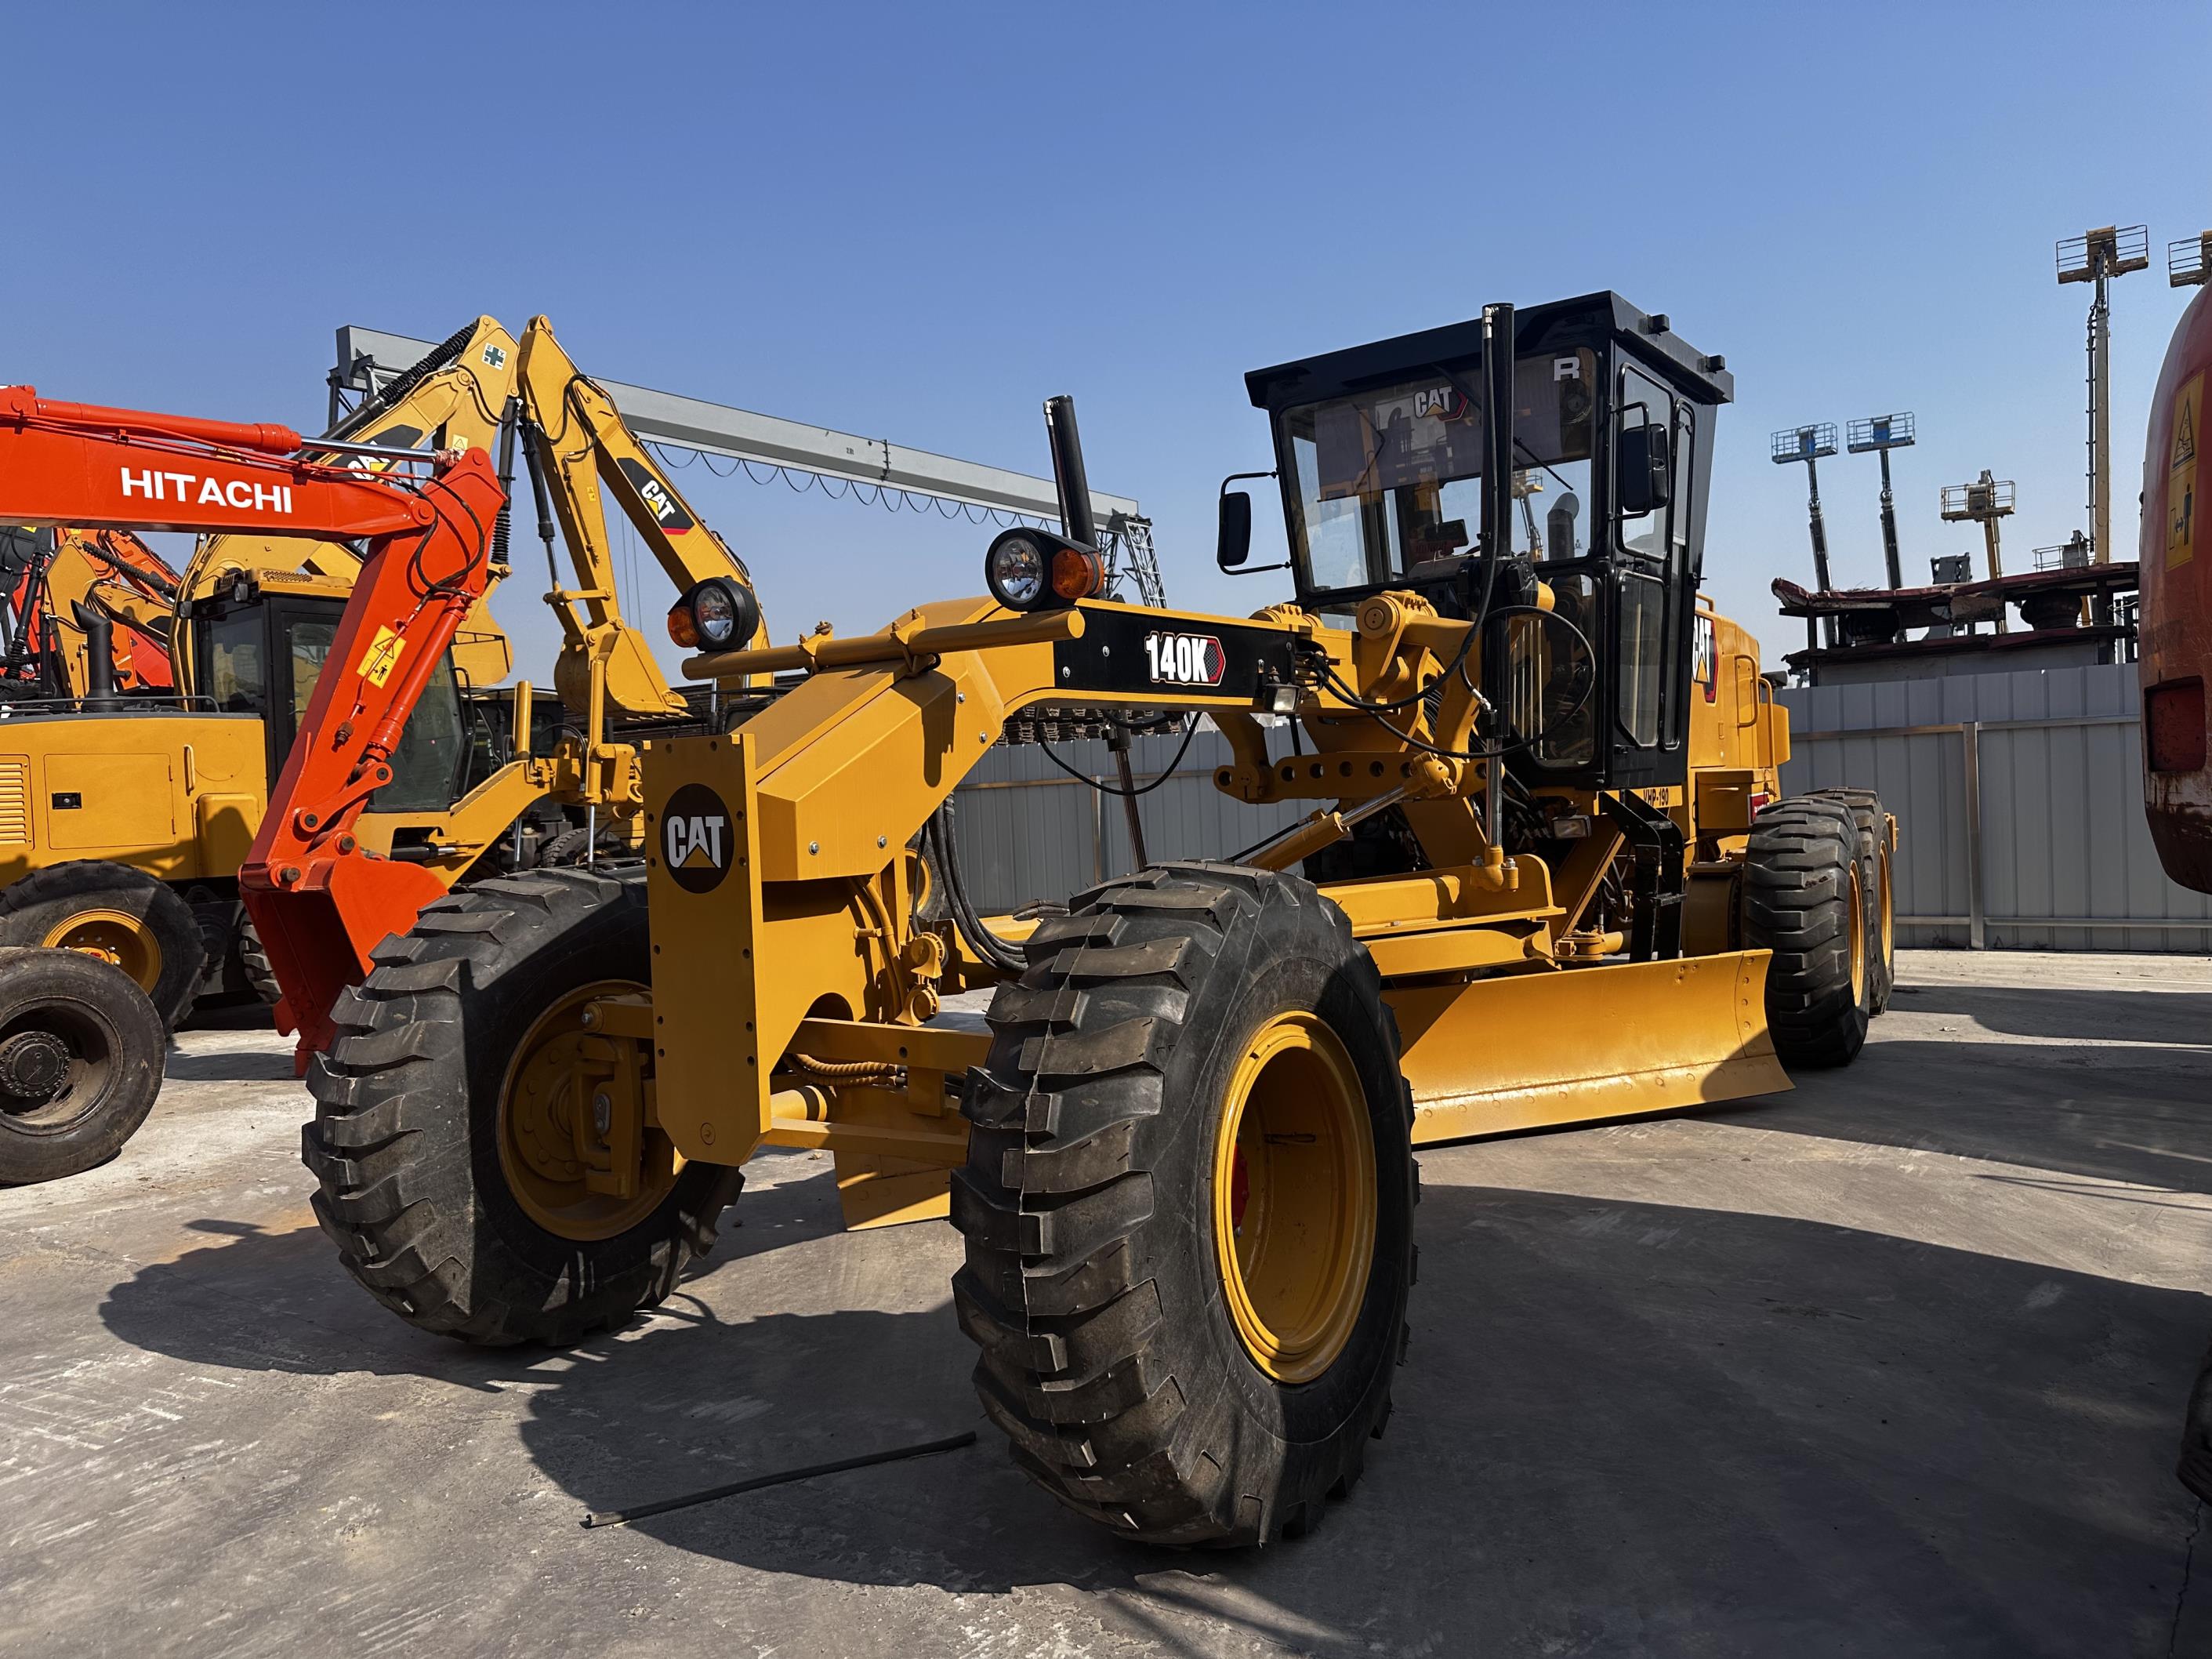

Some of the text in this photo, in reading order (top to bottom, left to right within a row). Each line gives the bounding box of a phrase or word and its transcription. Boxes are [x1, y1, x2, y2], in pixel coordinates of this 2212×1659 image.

[1554, 357, 1580, 381] R
[1414, 386, 1452, 417] CAT
[121, 466, 292, 514] HITACHI
[641, 480, 676, 521] CAT
[1145, 634, 1209, 682] 140K
[1692, 615, 1712, 684] CAT
[667, 815, 724, 868] CAT
